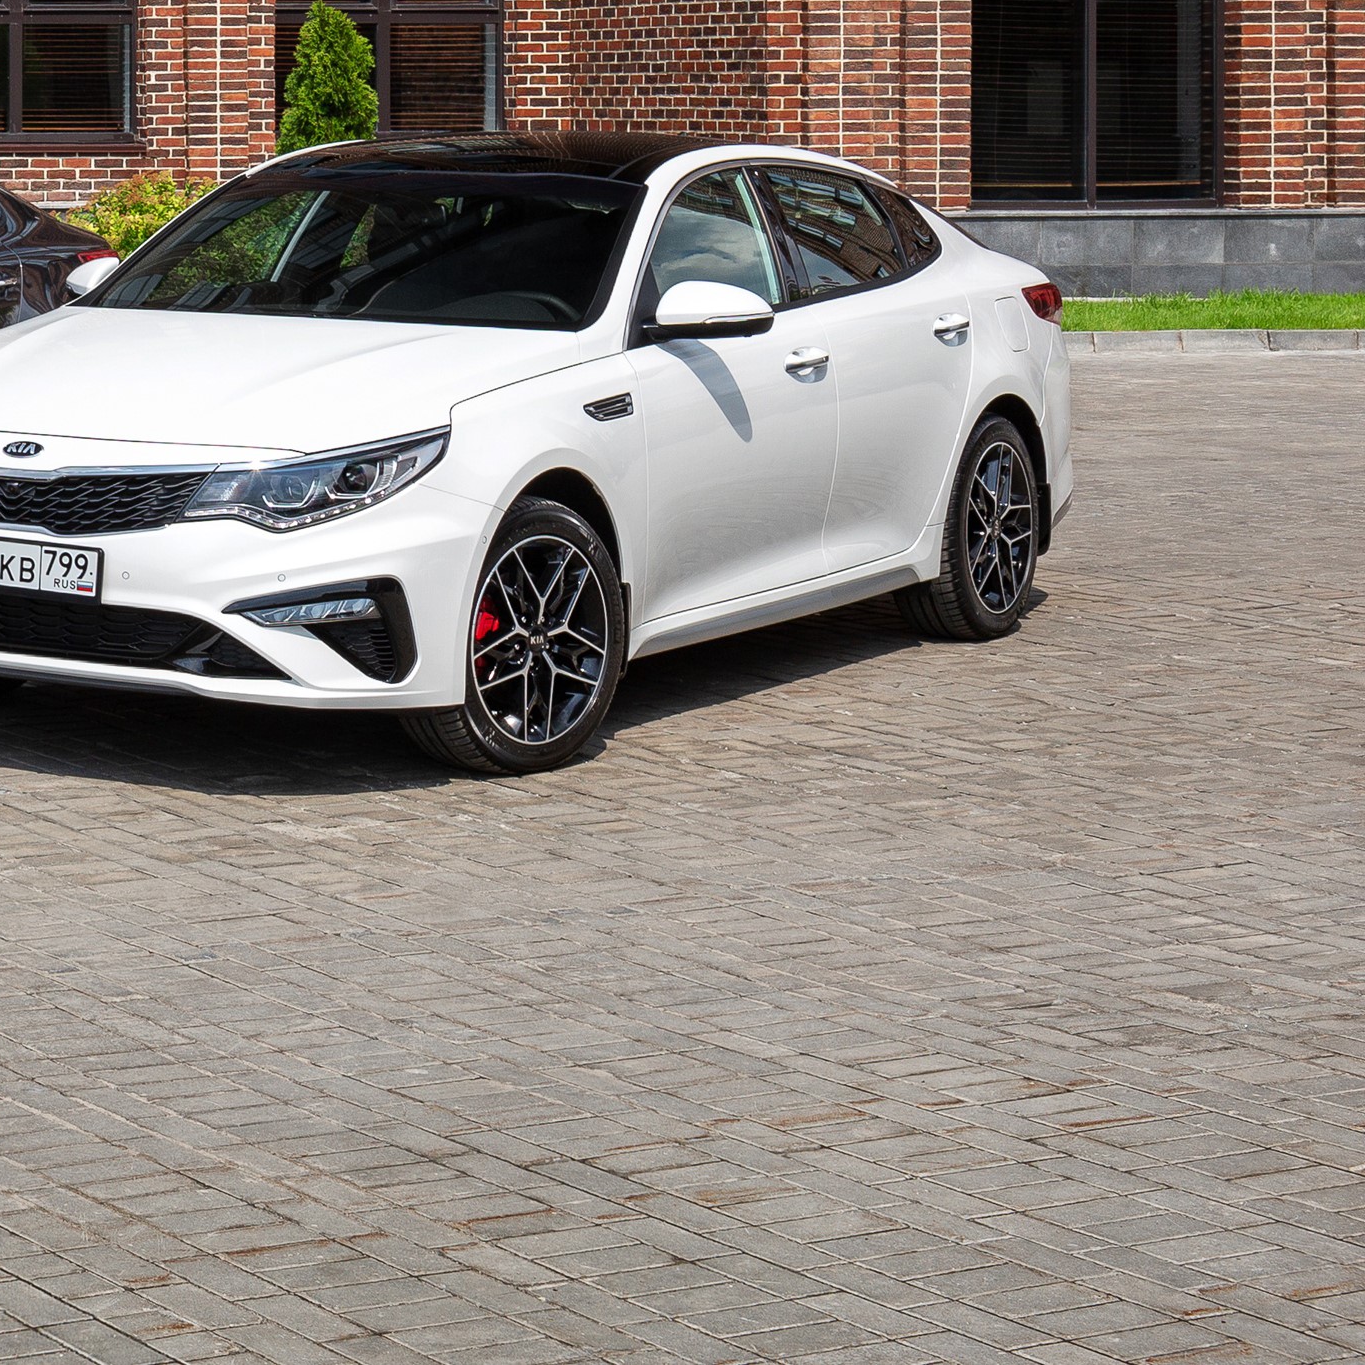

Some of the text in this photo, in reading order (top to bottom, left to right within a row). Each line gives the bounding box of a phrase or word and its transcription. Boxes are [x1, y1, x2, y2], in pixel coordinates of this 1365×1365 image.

[6, 441, 38, 455] KIA
[43, 549, 89, 580] 799
[53, 578, 76, 590] RUS
[530, 635, 544, 645] KIA
